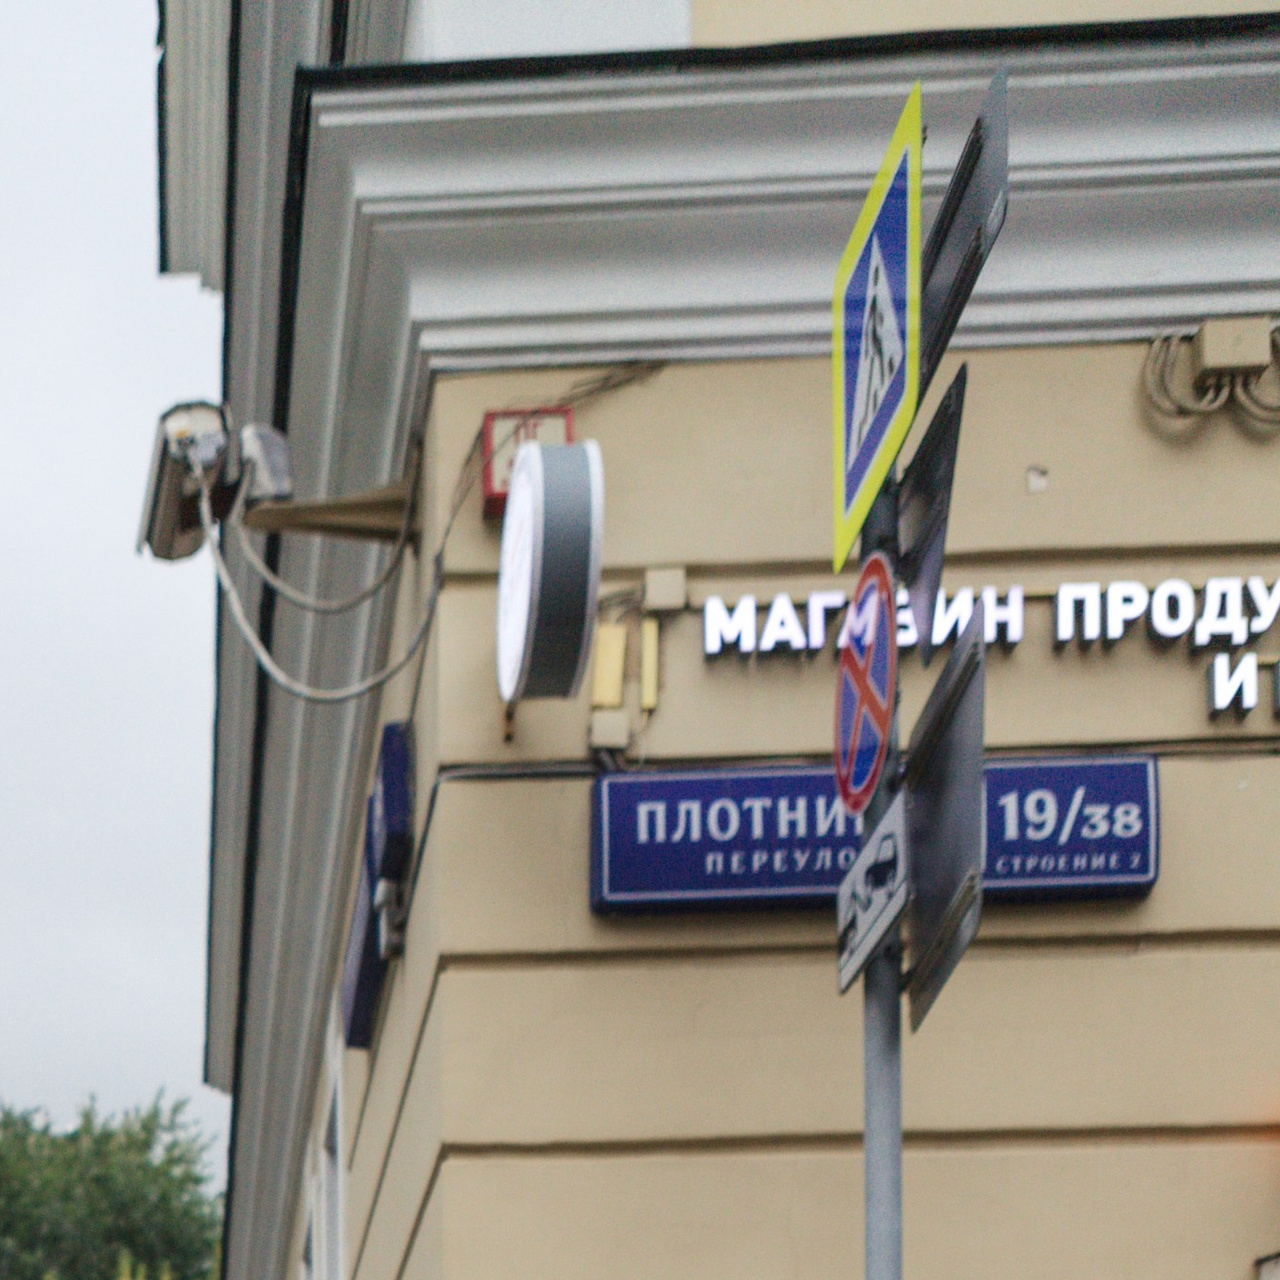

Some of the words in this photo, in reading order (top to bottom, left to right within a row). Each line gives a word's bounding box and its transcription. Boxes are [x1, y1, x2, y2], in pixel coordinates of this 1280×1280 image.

[1057, 576, 1280, 646] ПРОДУ
[1213, 651, 1258, 710] И
[636, 794, 864, 843] ПЛОТНИ
[997, 785, 1143, 846] 19/38
[995, 851, 1119, 874] СТРОЕНИЕ
